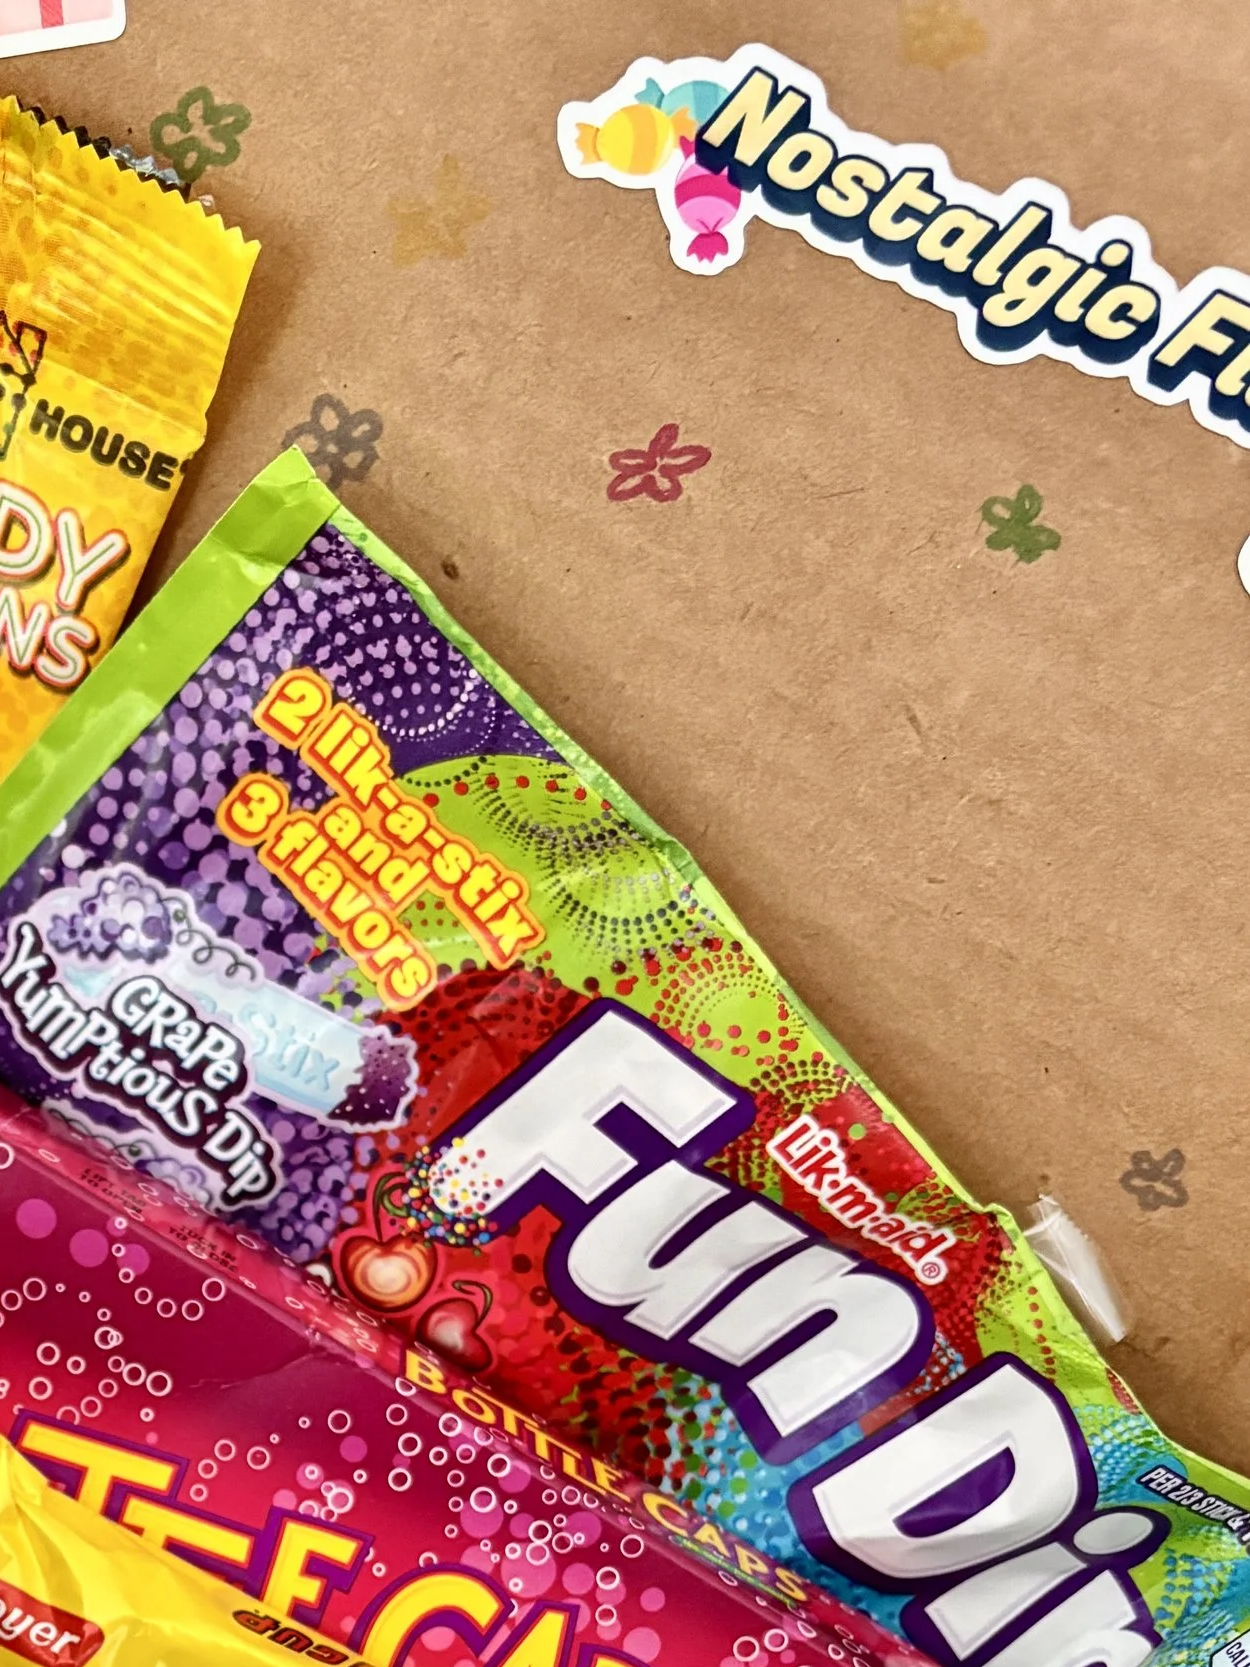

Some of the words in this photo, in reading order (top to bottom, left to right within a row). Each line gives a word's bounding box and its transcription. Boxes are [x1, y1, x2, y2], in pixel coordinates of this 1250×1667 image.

[694, 64, 1160, 365] Nostalgic
[29, 399, 172, 491] HOUSE
[226, 780, 285, 836] 3
[269, 820, 431, 1000] flavors
[264, 678, 326, 738] 2
[310, 711, 536, 960] lik-a-stix
[321, 804, 430, 905] and
[427, 1008, 921, 1438] Fun
[404, 1349, 631, 1502] BOTTLE
[643, 1492, 808, 1601] CAPS
[1140, 1467, 1179, 1499] PER
[1168, 1480, 1200, 1507] 2/3
